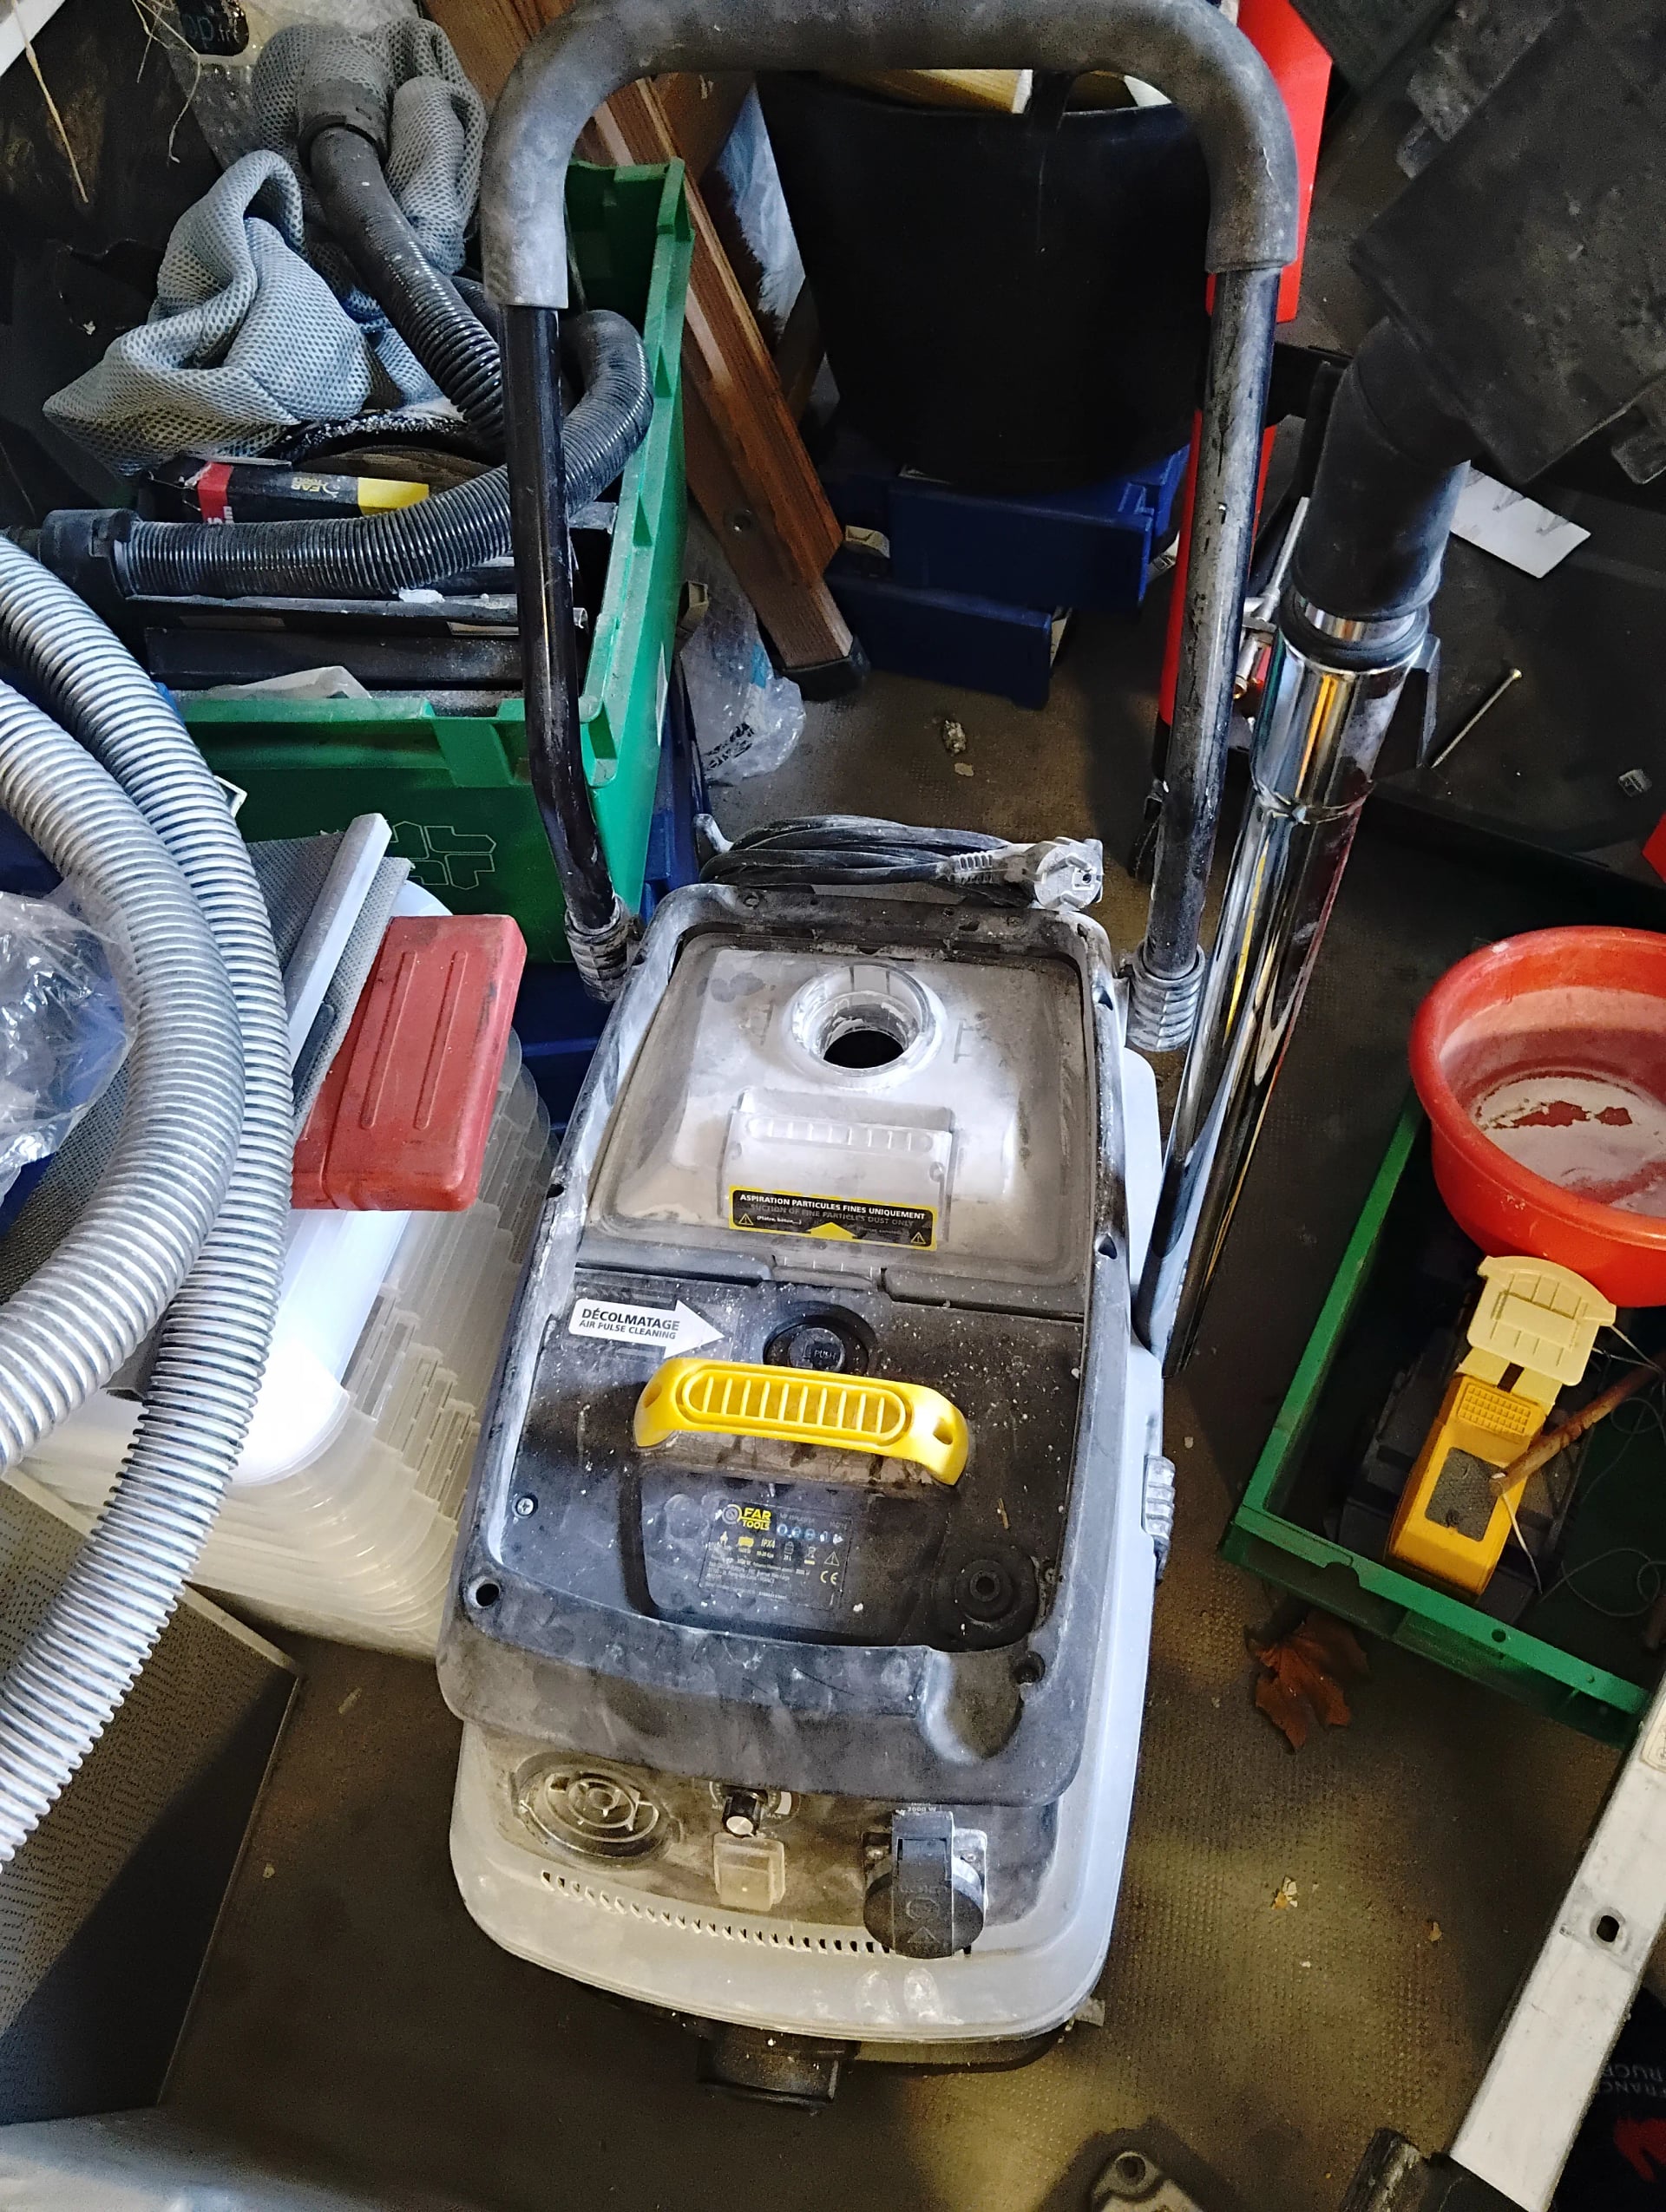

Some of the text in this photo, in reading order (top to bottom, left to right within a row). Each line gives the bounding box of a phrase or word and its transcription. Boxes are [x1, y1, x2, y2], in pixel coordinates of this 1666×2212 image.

[739, 1194, 925, 1220] ASPIRATION PARTICULES FINES UNIQUEMENT
[751, 1204, 787, 1214] SUCTION
[822, 1211, 866, 1222] PARTICLES
[868, 1215, 890, 1225] DUST
[892, 1218, 915, 1227] ONLY
[579, 1319, 676, 1339] AIR PULSE CLEANING
[581, 1307, 680, 1332] DÉCOLMATAGE
[744, 1507, 772, 1520] FAR
[742, 1519, 771, 1531] TOOLS
[760, 1537, 776, 1549] IPX4
